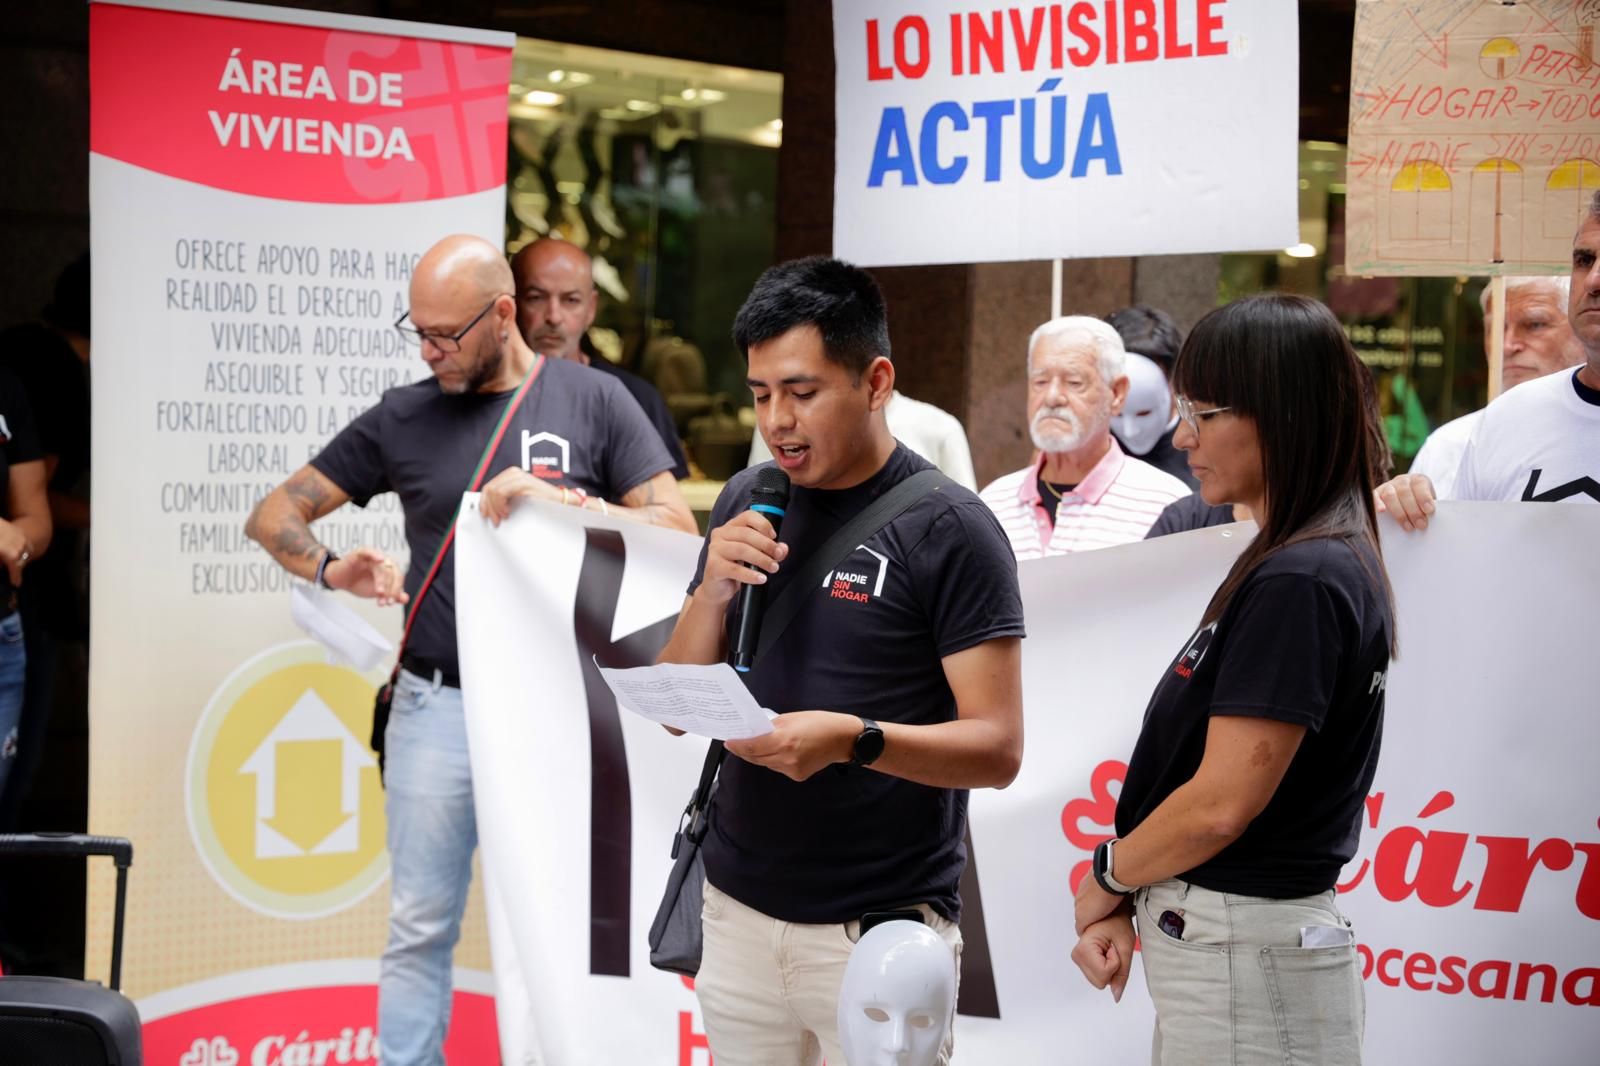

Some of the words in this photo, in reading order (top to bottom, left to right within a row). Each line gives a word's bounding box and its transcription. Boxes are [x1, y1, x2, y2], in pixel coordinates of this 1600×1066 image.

[865, 15, 930, 81] LO
[950, 0, 1229, 76] INVISIBLE
[218, 48, 336, 102] ÁREA
[348, 69, 404, 107] DE
[1378, 84, 1519, 121] HOGAR
[208, 110, 415, 162] VIVIENDA
[866, 78, 1123, 188] ACTÚA
[1375, 139, 1472, 177] NADIE
[175, 239, 247, 273] OFRECE
[257, 244, 320, 277] APOYO
[330, 248, 375, 280] PARA
[166, 279, 257, 315] REALIDAD
[268, 284, 287, 316] EL
[298, 286, 382, 319] DERECHO
[211, 322, 301, 354] VIVIENDA
[205, 361, 304, 396] ASEQUIBLE
[316, 366, 329, 396] Y
[157, 401, 307, 435] FORTALECIENDO
[317, 405, 338, 436] LA
[208, 443, 290, 474] LABORAL
[318, 515, 406, 553] ITUACIÓN
[831, 588, 869, 603] HOGAR
[833, 580, 851, 590] SIN
[835, 571, 868, 585] NADIE
